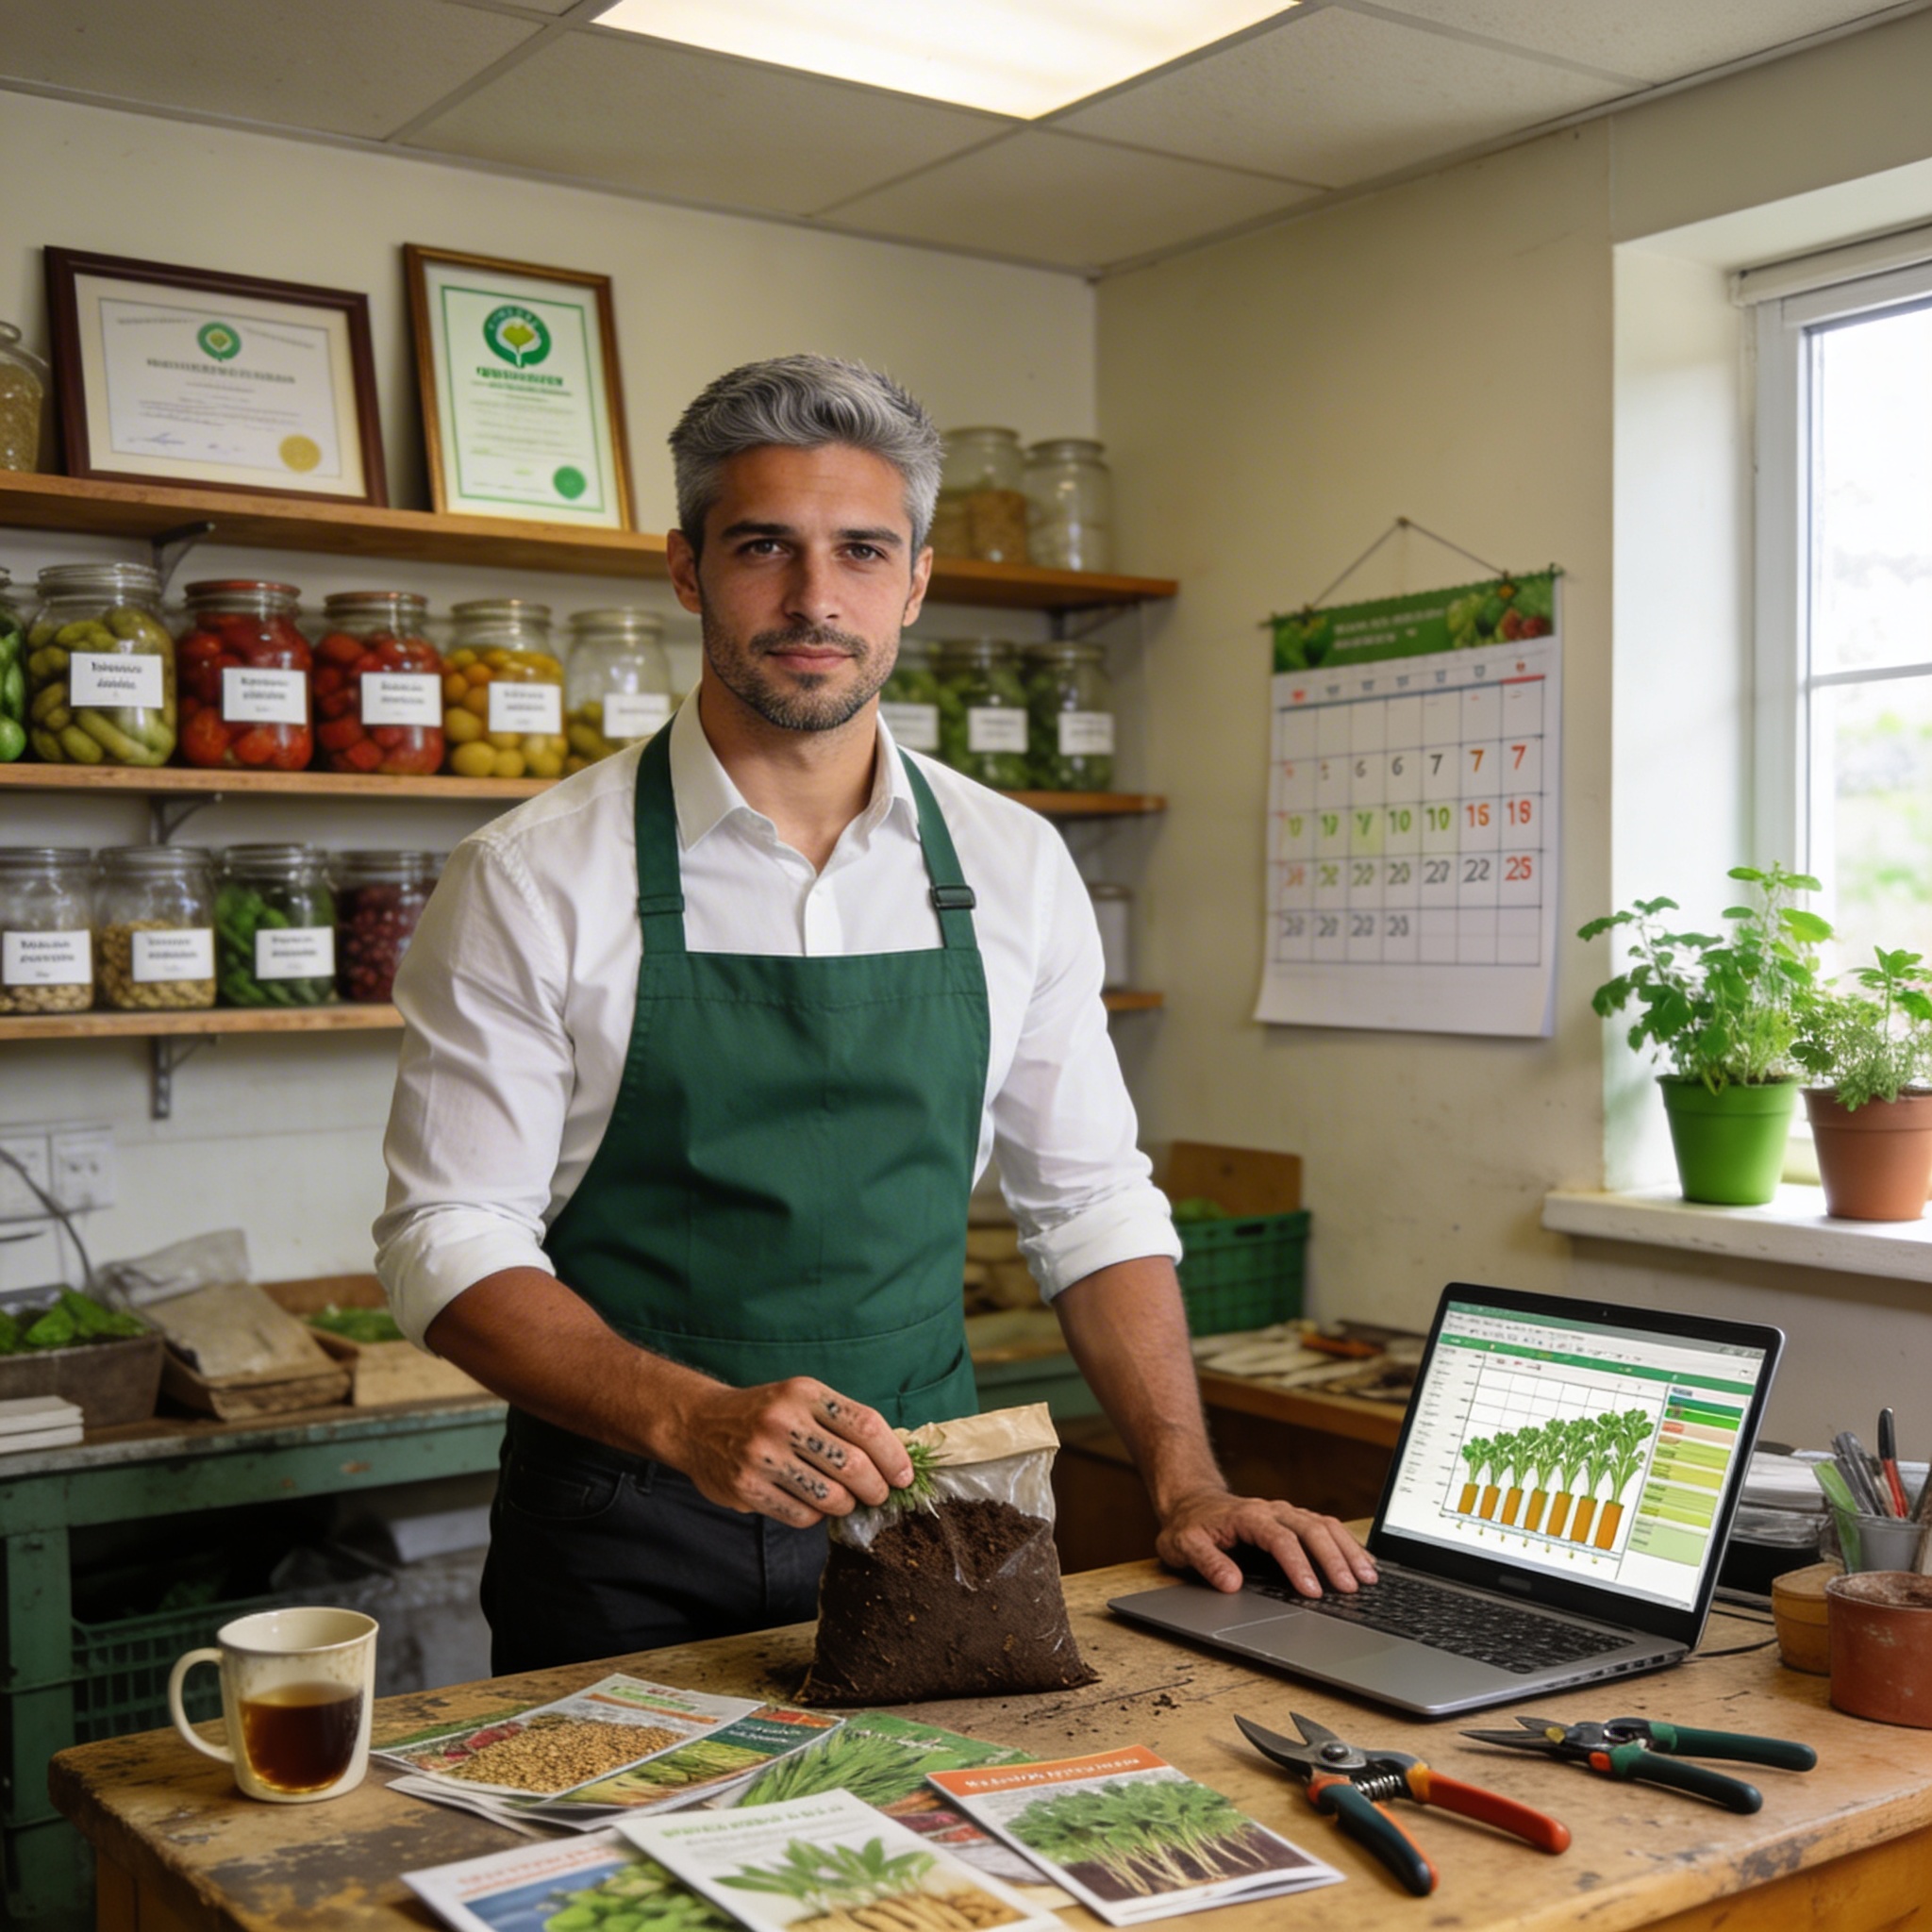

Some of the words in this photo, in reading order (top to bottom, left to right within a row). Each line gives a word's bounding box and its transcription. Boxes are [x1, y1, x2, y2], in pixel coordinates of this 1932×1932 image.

[1429, 754, 1443, 775] 7
[1470, 749, 1485, 773] 7
[1511, 744, 1526, 770] 7
